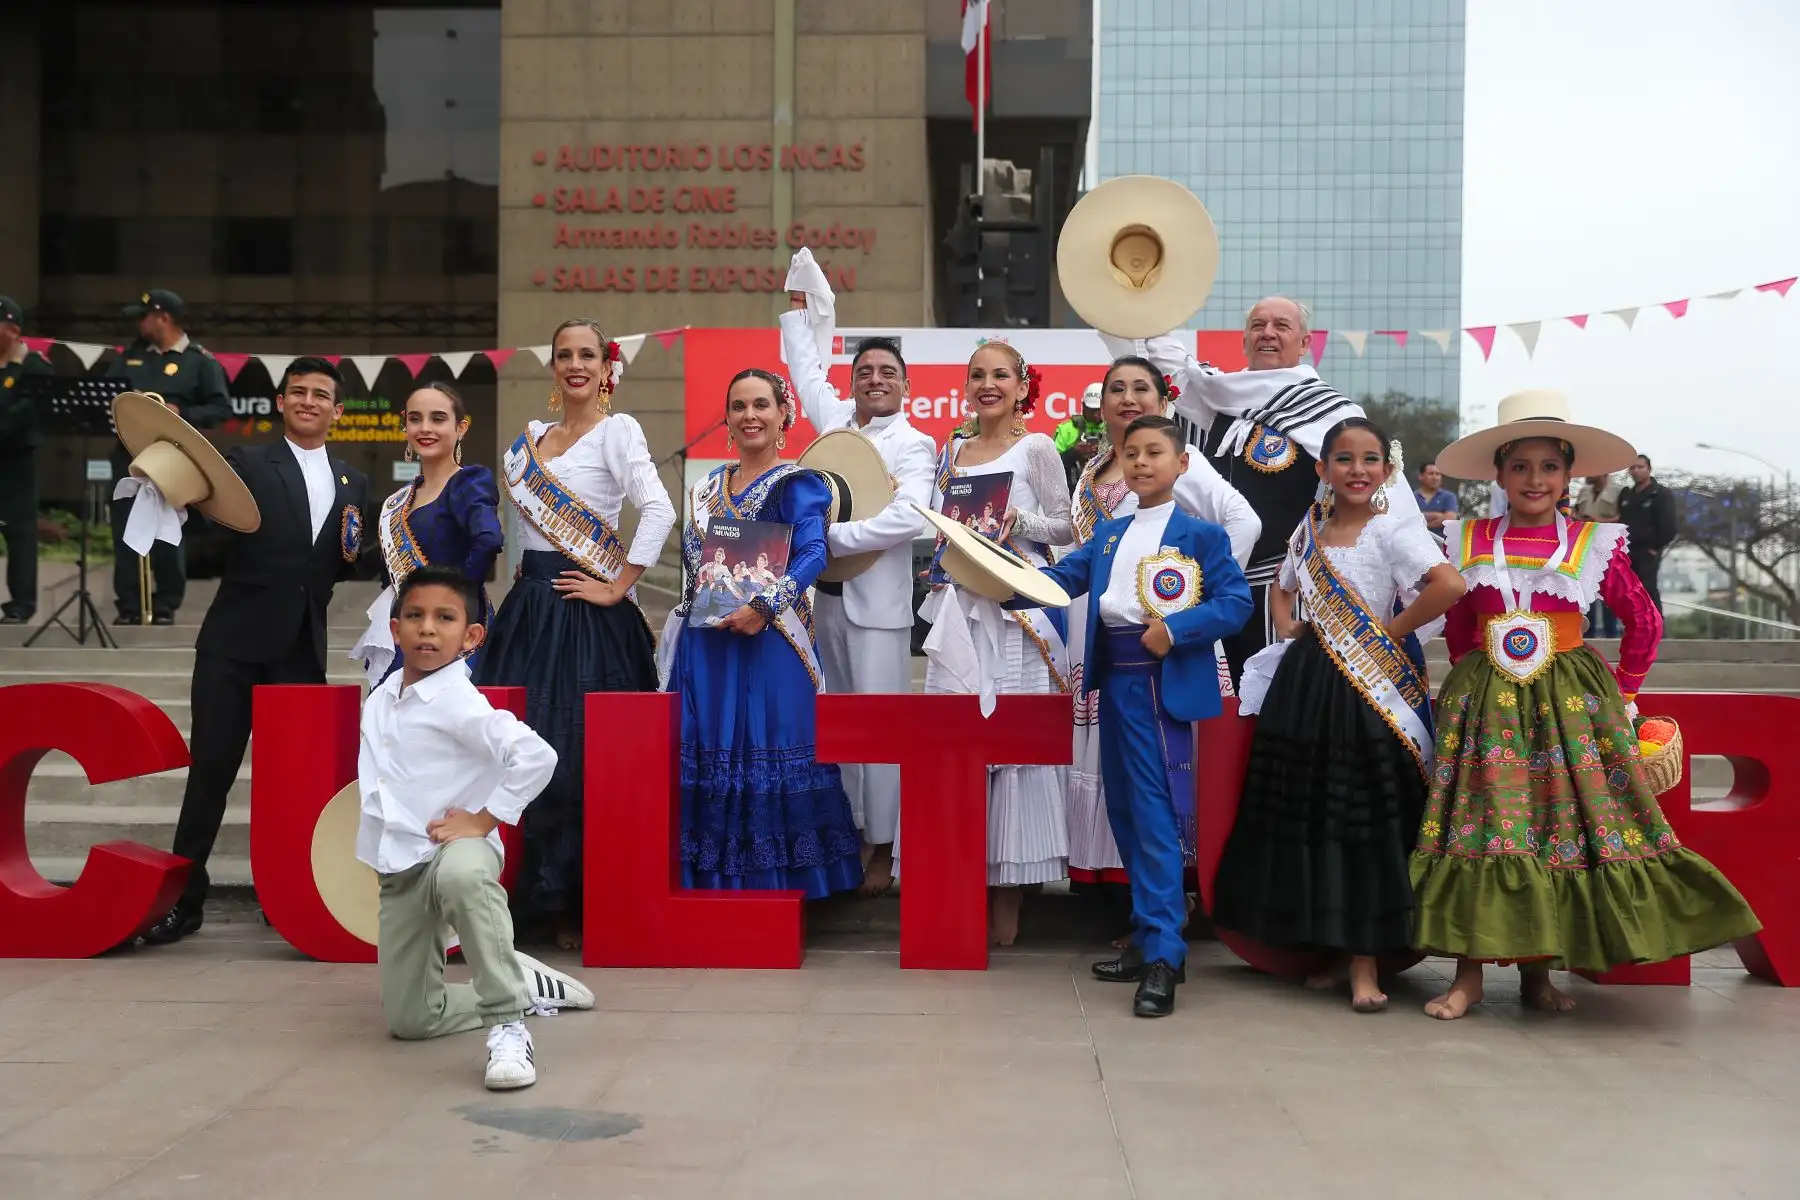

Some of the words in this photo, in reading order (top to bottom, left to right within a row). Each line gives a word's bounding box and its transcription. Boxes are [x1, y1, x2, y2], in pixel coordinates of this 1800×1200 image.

[554, 143, 712, 172] AUDITORIO
[718, 143, 773, 172] LOS
[780, 143, 866, 172] INCAS
[552, 186, 623, 214] SALA
[627, 186, 666, 213] DE
[672, 186, 738, 213] CINE
[553, 222, 680, 250] Armando
[687, 222, 778, 250] Robles
[785, 222, 876, 255] Godoy
[552, 266, 637, 293] SALAS
[645, 266, 684, 293] DE
[231, 397, 271, 415] ura
[1044, 392, 1083, 419] Cu
[951, 488, 972, 496] MUNDO
[557, 503, 597, 539] NACIONAL
[714, 529, 740, 538] MUNDO
[541, 508, 588, 550] CAMPEONA
[587, 543, 620, 575] SENIOR
[1326, 592, 1364, 636] NACIONAL
[1309, 591, 1348, 646] CAMPEONA
[1344, 642, 1388, 689] INFANTE
[1356, 629, 1376, 647] DE
[1365, 638, 1406, 685] MARINERA
[1399, 680, 1424, 709] 2023
